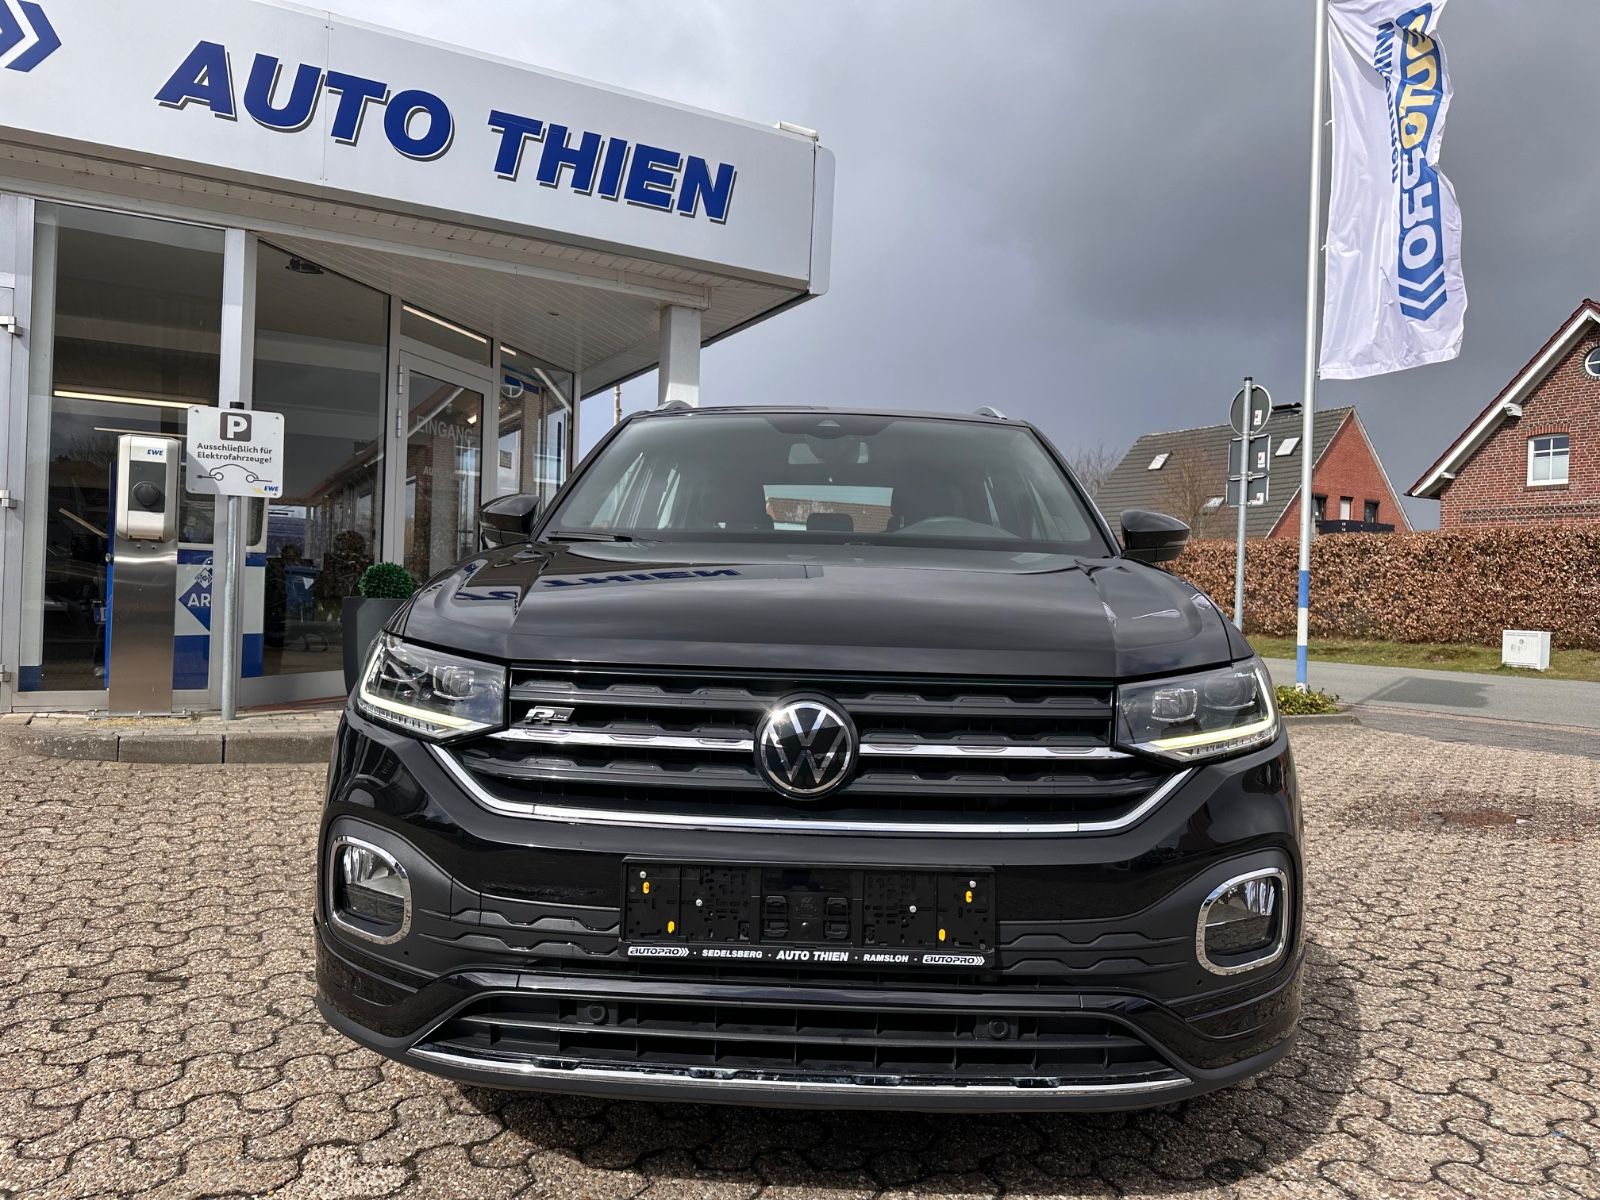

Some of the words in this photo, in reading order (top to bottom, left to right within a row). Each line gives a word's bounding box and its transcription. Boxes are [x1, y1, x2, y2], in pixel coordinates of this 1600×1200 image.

[154, 40, 456, 162] AUTO
[488, 109, 738, 224] THIEN
[227, 415, 248, 439] P
[197, 443, 259, 454] Ausschließlich
[260, 447, 273, 455] für
[197, 451, 273, 464] Elektrofahrzeuge!
[187, 593, 211, 607] AR
[702, 949, 763, 958] SEDELSBERG
[776, 950, 810, 960] AUTO
[813, 951, 849, 962] THIEN
[863, 954, 909, 962] RAMSLOH
